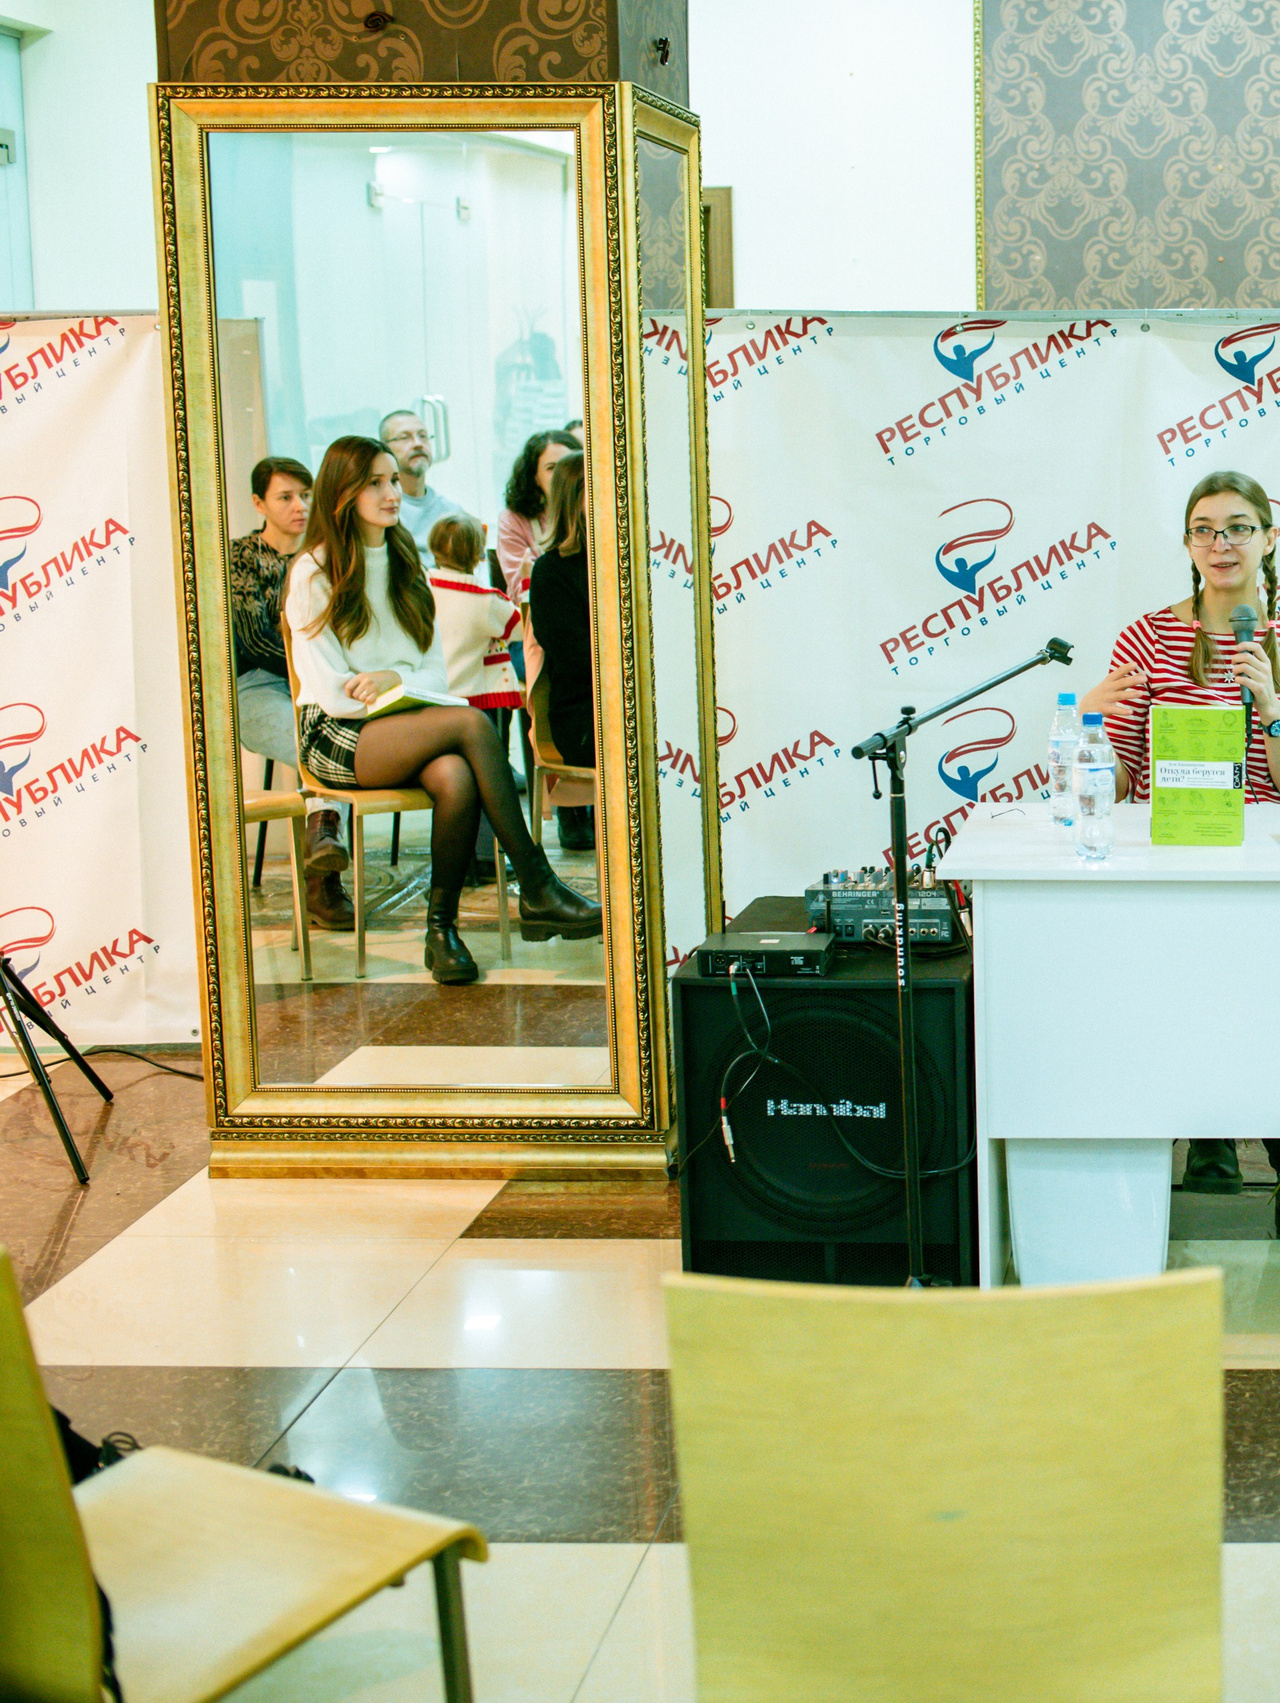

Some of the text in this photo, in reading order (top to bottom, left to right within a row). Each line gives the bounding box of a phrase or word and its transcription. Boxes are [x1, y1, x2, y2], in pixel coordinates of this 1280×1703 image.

[0, 316, 119, 400] БЛИКА
[56, 327, 126, 379] ЦЕНТР
[707, 316, 827, 388] БЛИКА
[757, 327, 834, 376] ЦЕНТР
[875, 320, 1112, 454] РЕСПУБЛИКА
[887, 328, 1118, 466] ТОРГОВЫЙ ЦЕНТР
[0, 517, 129, 618] УБЛИКА
[65, 536, 136, 587] ЦЕНТР
[711, 519, 832, 601] БЛИКА
[760, 538, 838, 590] ЦЕНТР
[879, 521, 1112, 665] РЕСПУБЛИКА
[891, 540, 1118, 676] ТОРГОВЫЙ ЦЕНТР
[0, 725, 141, 823] УБЛИКА
[75, 743, 148, 794] ЦЕНТР
[718, 730, 835, 810] БЛИКА
[763, 748, 841, 799] ЦЕНТР
[85, 944, 160, 996] ЦЕНТР
[896, 903, 906, 987] soundking
